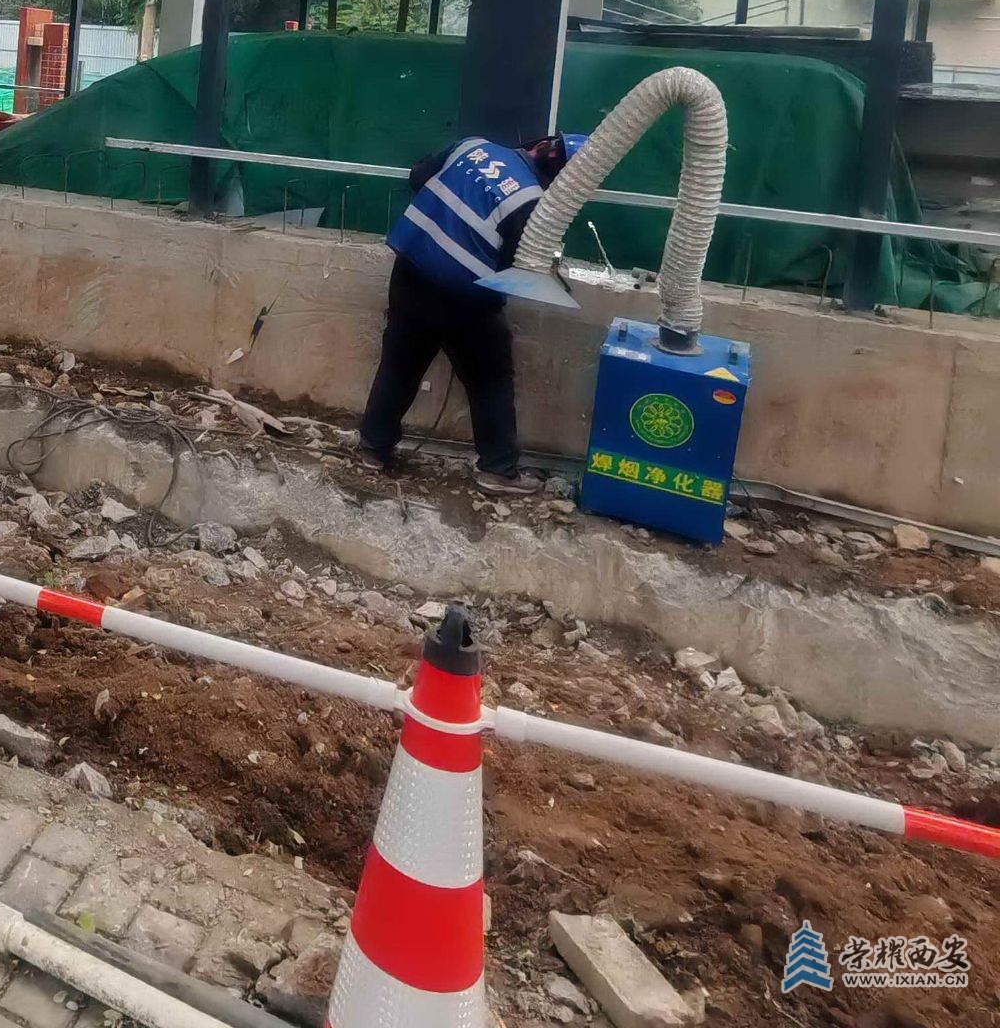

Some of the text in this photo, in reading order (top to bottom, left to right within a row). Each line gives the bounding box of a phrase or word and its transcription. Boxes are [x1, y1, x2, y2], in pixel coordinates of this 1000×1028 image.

[591, 451, 724, 501] 焊烟净化器
